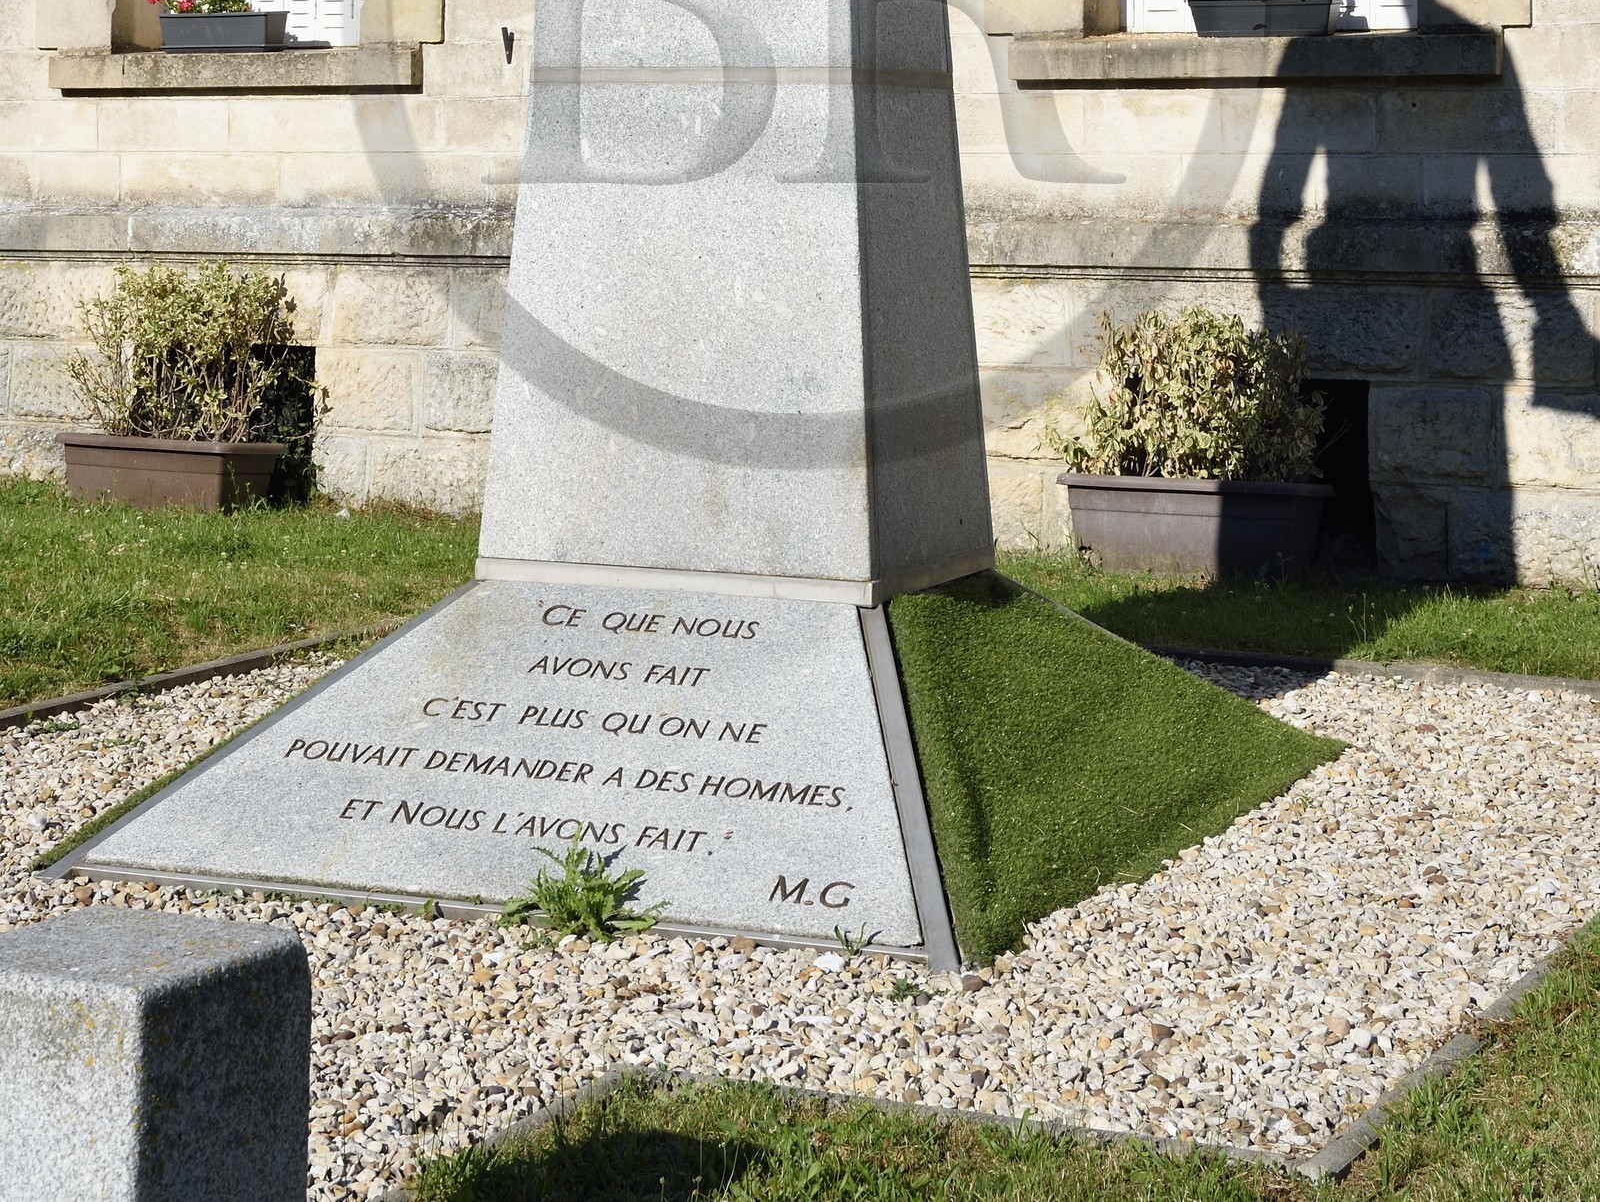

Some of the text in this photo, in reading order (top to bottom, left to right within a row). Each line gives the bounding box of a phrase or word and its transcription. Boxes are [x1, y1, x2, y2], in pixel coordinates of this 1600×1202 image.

[601, 611, 665, 635] QUE
[671, 616, 760, 640] NOUS
[527, 655, 711, 687] AVONS FAIT
[422, 696, 507, 722] C'EST
[517, 705, 589, 729] PLUS
[717, 721, 768, 744] NE
[284, 738, 853, 812] POUVAIT DEMANDER A DES HOMMES,
[339, 798, 383, 820] ET
[389, 799, 487, 831] NOUS
[491, 811, 626, 845] L'AVONS
[768, 874, 856, 909] M.G
